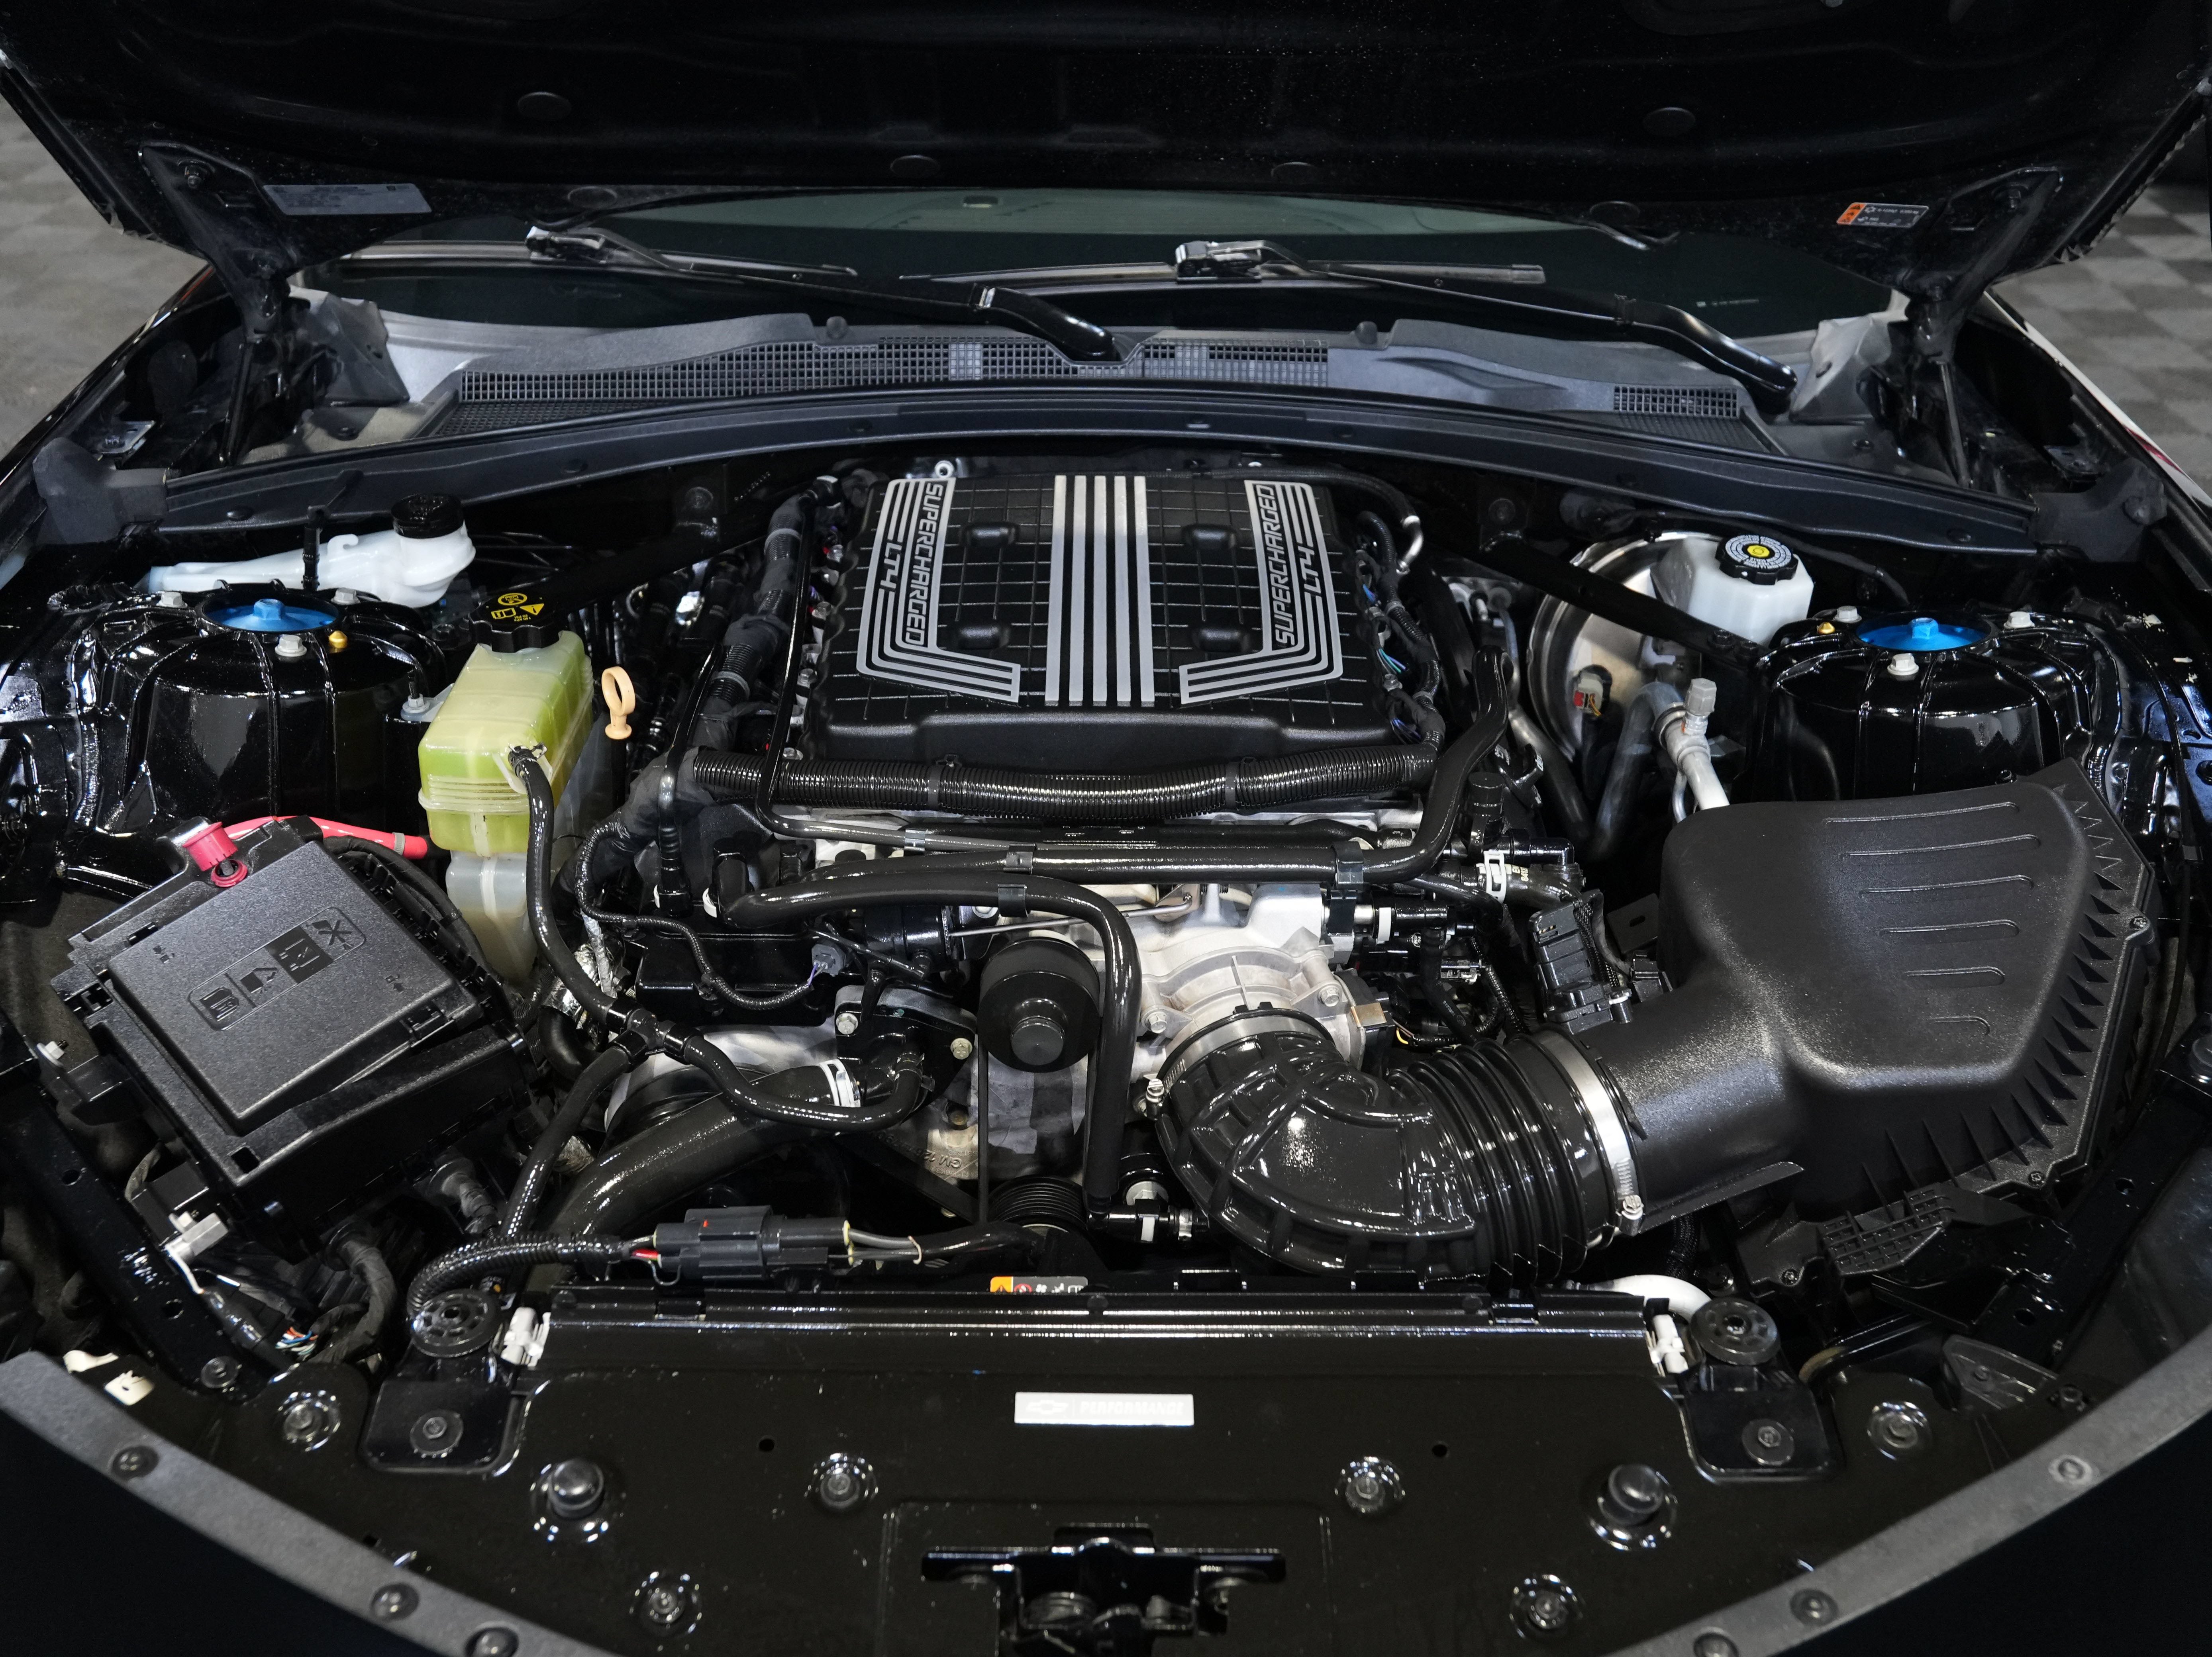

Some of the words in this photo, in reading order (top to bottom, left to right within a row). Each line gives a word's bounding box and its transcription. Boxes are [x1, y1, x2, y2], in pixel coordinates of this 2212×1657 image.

[880, 542, 902, 589] LT4
[905, 482, 944, 646] SUPERCHARGED
[1255, 484, 1295, 646] SUPERCHARGED
[1297, 545, 1322, 594] LT4
[1080, 1400, 1184, 1416] PERFORMANCE
